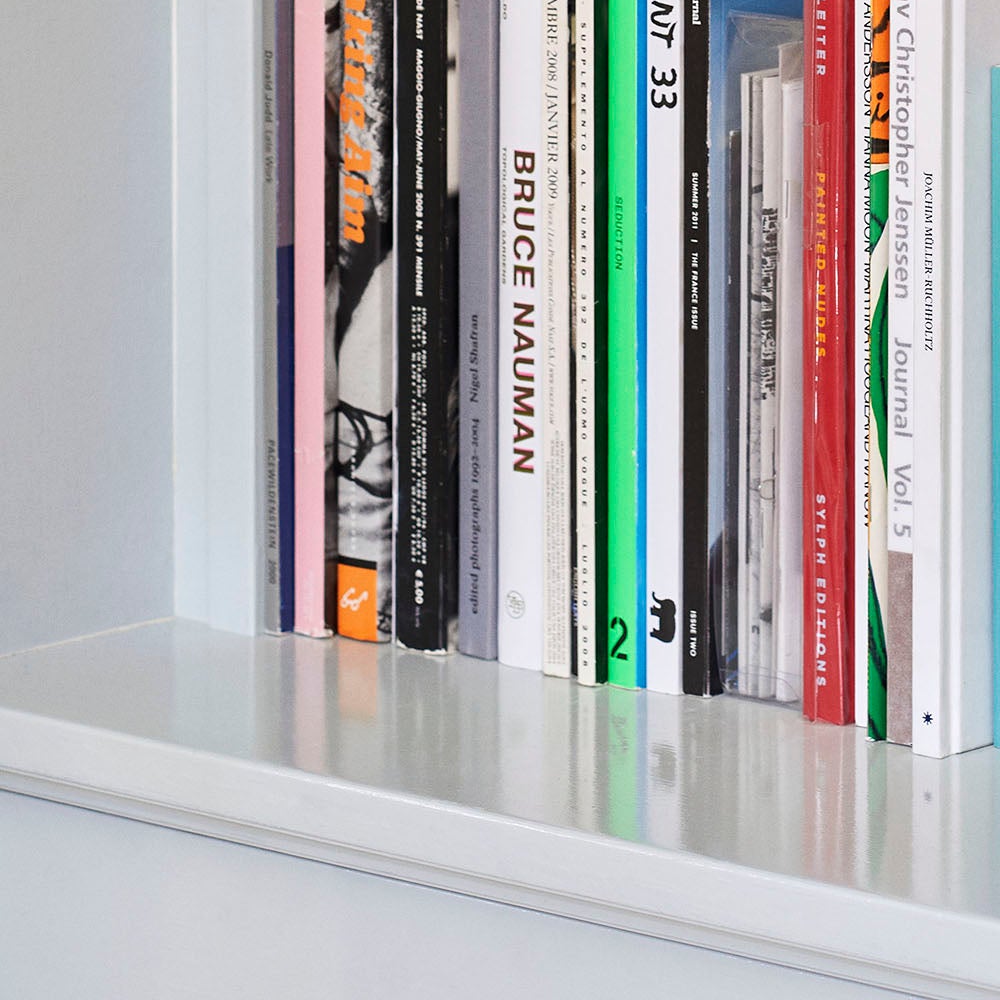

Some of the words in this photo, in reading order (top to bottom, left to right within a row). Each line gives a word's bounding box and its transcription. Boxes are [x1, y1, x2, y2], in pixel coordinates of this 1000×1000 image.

[415, 12, 424, 40] NAST
[546, 50, 559, 82] 2008
[650, 66, 678, 110] 33
[415, 49, 424, 190] MAGGIO-GIUGNO/MAY-JUNE
[546, 92, 559, 163] JANVIER
[891, 28, 915, 188] Christopher
[343, 133, 374, 244] Aim
[546, 167, 559, 199] 2009
[581, 169, 588, 188] AL
[690, 172, 699, 209] SUMMER
[924, 172, 934, 223] JOACHIM
[513, 150, 536, 289] BRUCE
[615, 196, 624, 271] SEDUCTION
[690, 211, 699, 230] 2011
[816, 171, 826, 271] PAINTED
[690, 252, 699, 268] THE
[894, 195, 913, 299] Jenssen
[415, 256, 424, 297] MENSILE
[690, 270, 699, 304] FRANCE
[924, 226, 934, 352] MÜLLER-RUCHHOLTZ
[469, 314, 480, 365] Shafran
[690, 306, 699, 331] ISSUE
[816, 284, 826, 359] NUDES
[581, 342, 588, 362] DE
[469, 369, 480, 403] Nigel
[513, 301, 536, 476] NAUMAN
[894, 338, 913, 438] Journal
[894, 464, 912, 512] Vol.
[470, 488, 480, 571] photographs
[816, 494, 827, 564] SYLPH
[894, 522, 912, 539] 5
[470, 572, 480, 615] edited
[610, 616, 628, 661] 2
[690, 610, 698, 634] ISSUE
[816, 577, 827, 689] EDITIONS
[690, 637, 698, 657] TWO
